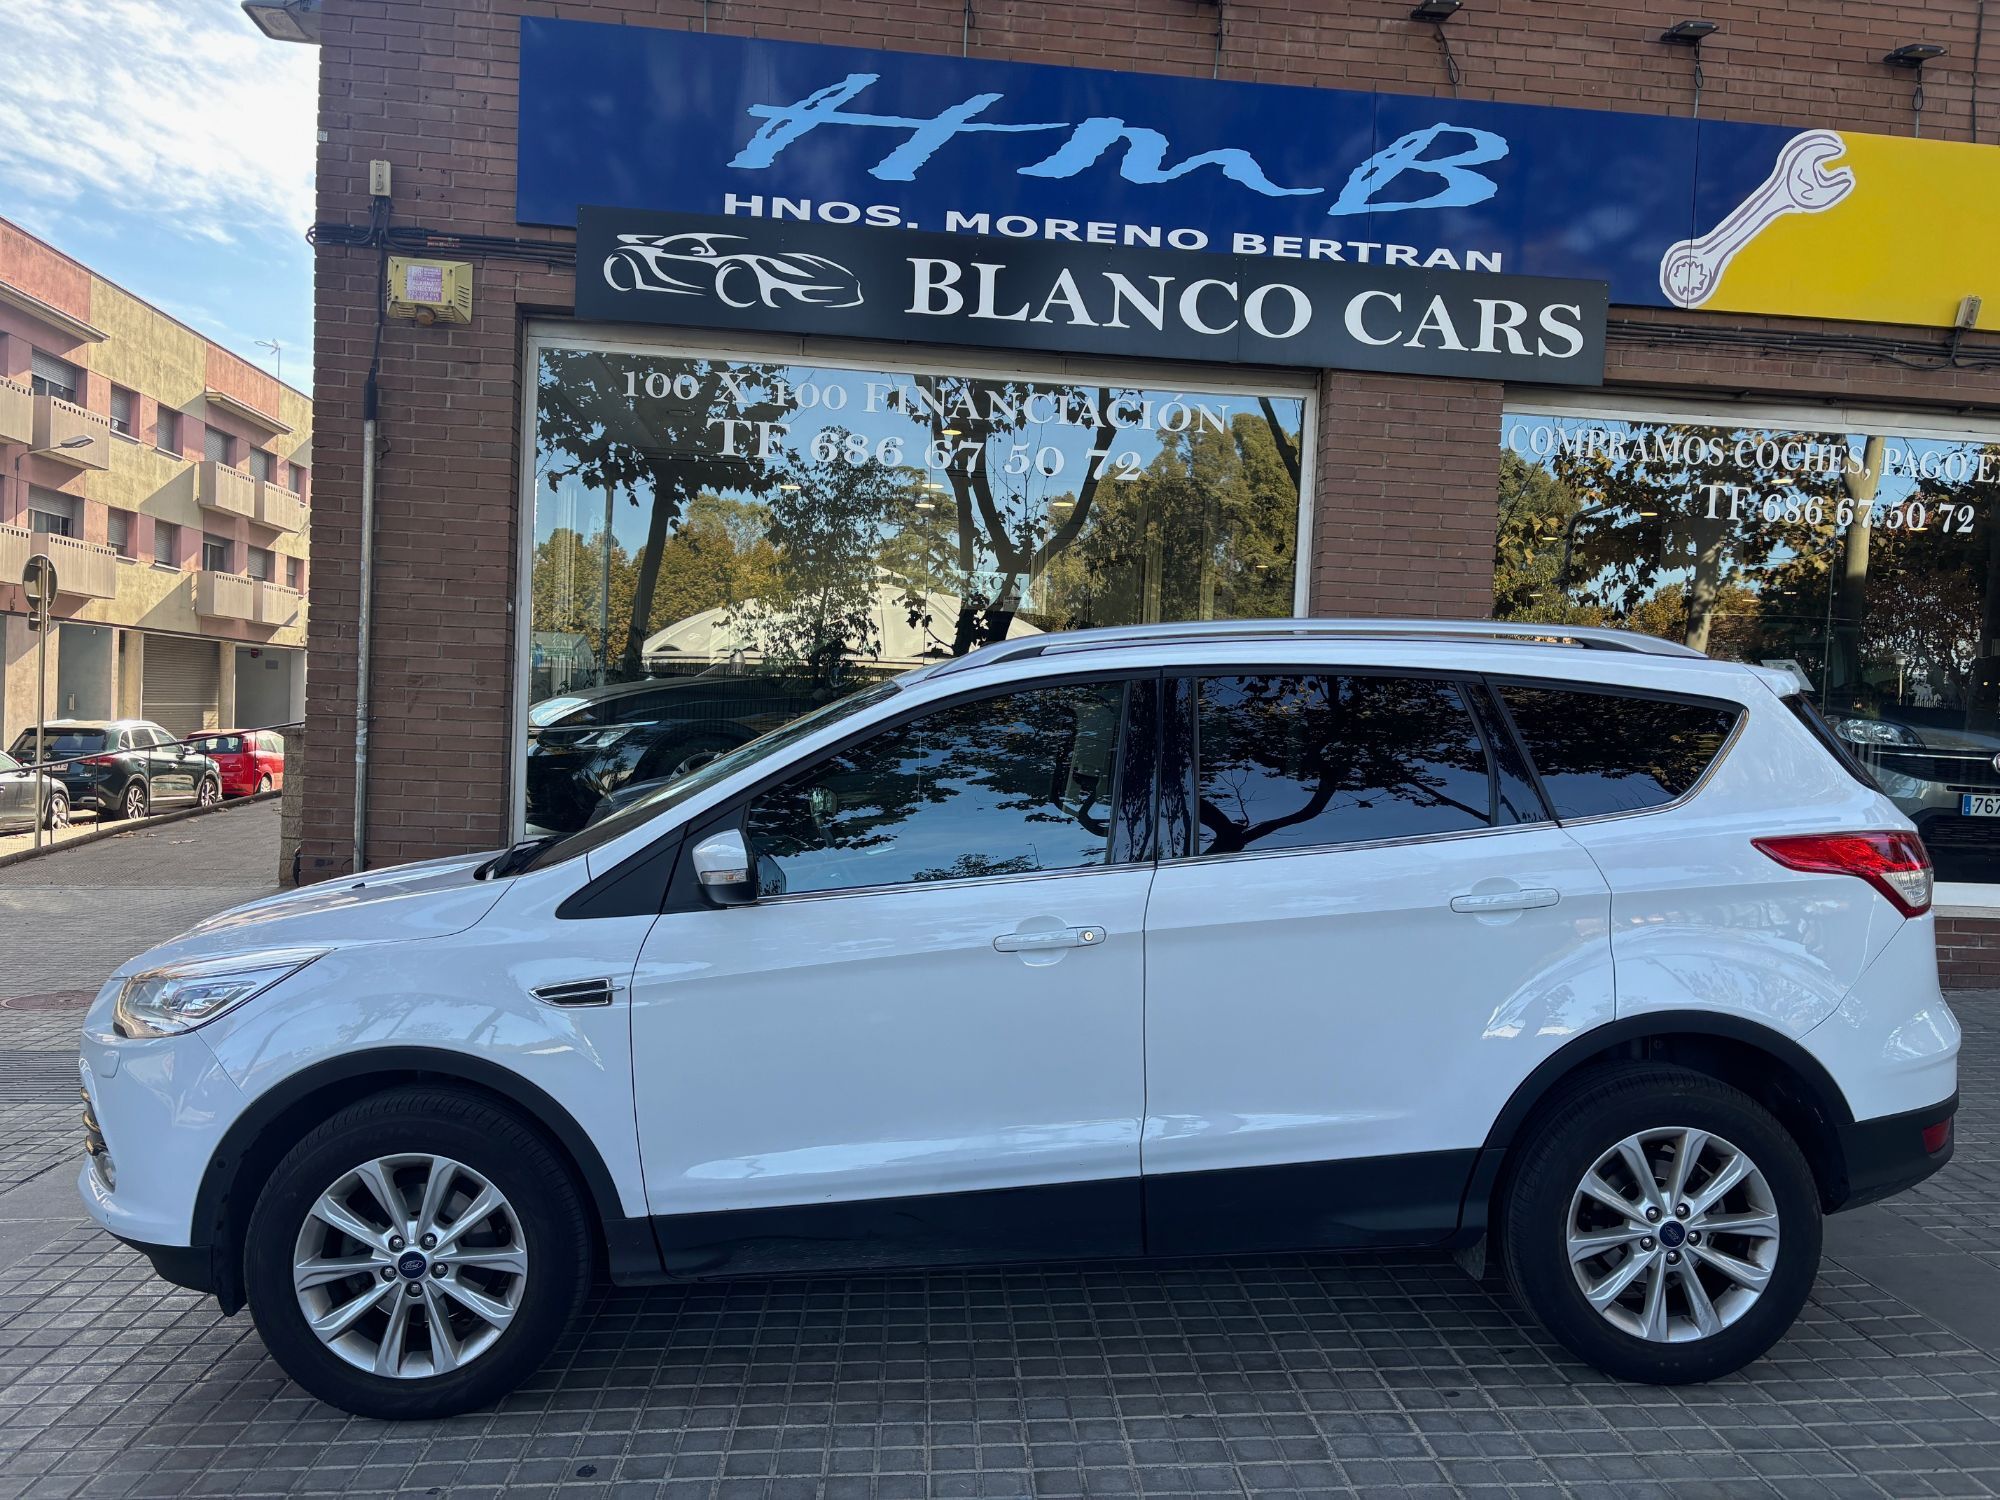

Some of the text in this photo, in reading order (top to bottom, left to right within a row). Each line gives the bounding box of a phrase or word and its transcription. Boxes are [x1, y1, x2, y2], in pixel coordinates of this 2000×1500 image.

[724, 193, 1502, 273] HNOS. MORENO BERTRAN
[904, 257, 1584, 358] BLANCO CARS
[622, 371, 1231, 434] 100 X 100 FINANCIACIÓN
[706, 418, 1142, 481] TF 686 67 50 72
[1508, 424, 2000, 483] COMPRAMOS COCHES, PAGO E
[1699, 484, 1976, 533] TF 686 67 50 72
